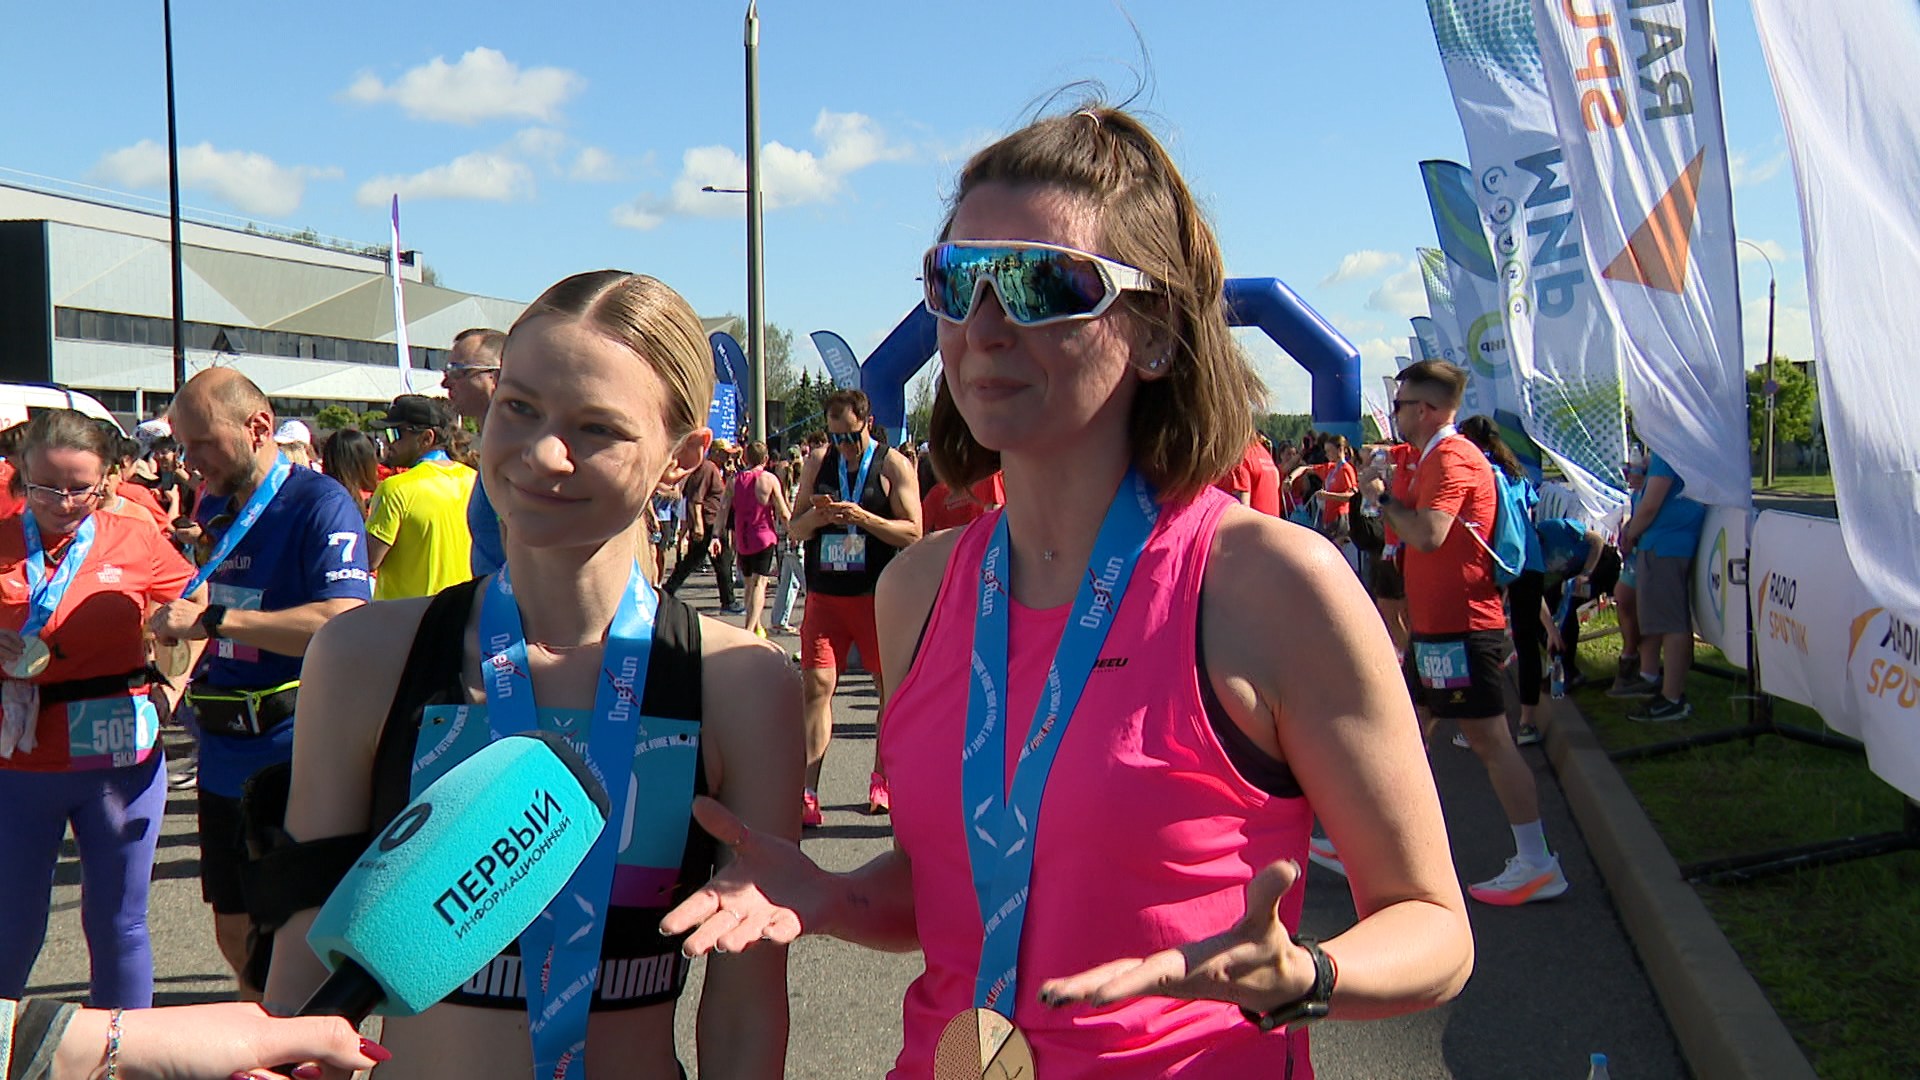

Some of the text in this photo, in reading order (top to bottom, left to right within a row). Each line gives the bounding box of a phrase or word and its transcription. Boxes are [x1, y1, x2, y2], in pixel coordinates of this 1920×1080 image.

[327, 532, 358, 563] 7
[982, 546, 1000, 617] OneRun
[1080, 556, 1124, 630] OneRun
[1769, 572, 1797, 610] RADIO
[608, 656, 639, 722] OneRun
[1423, 655, 1454, 677] 5128
[433, 788, 562, 926] ПЕРВЫЙ
[454, 815, 572, 939] ИНФОРМАЦИОННЫЙ
